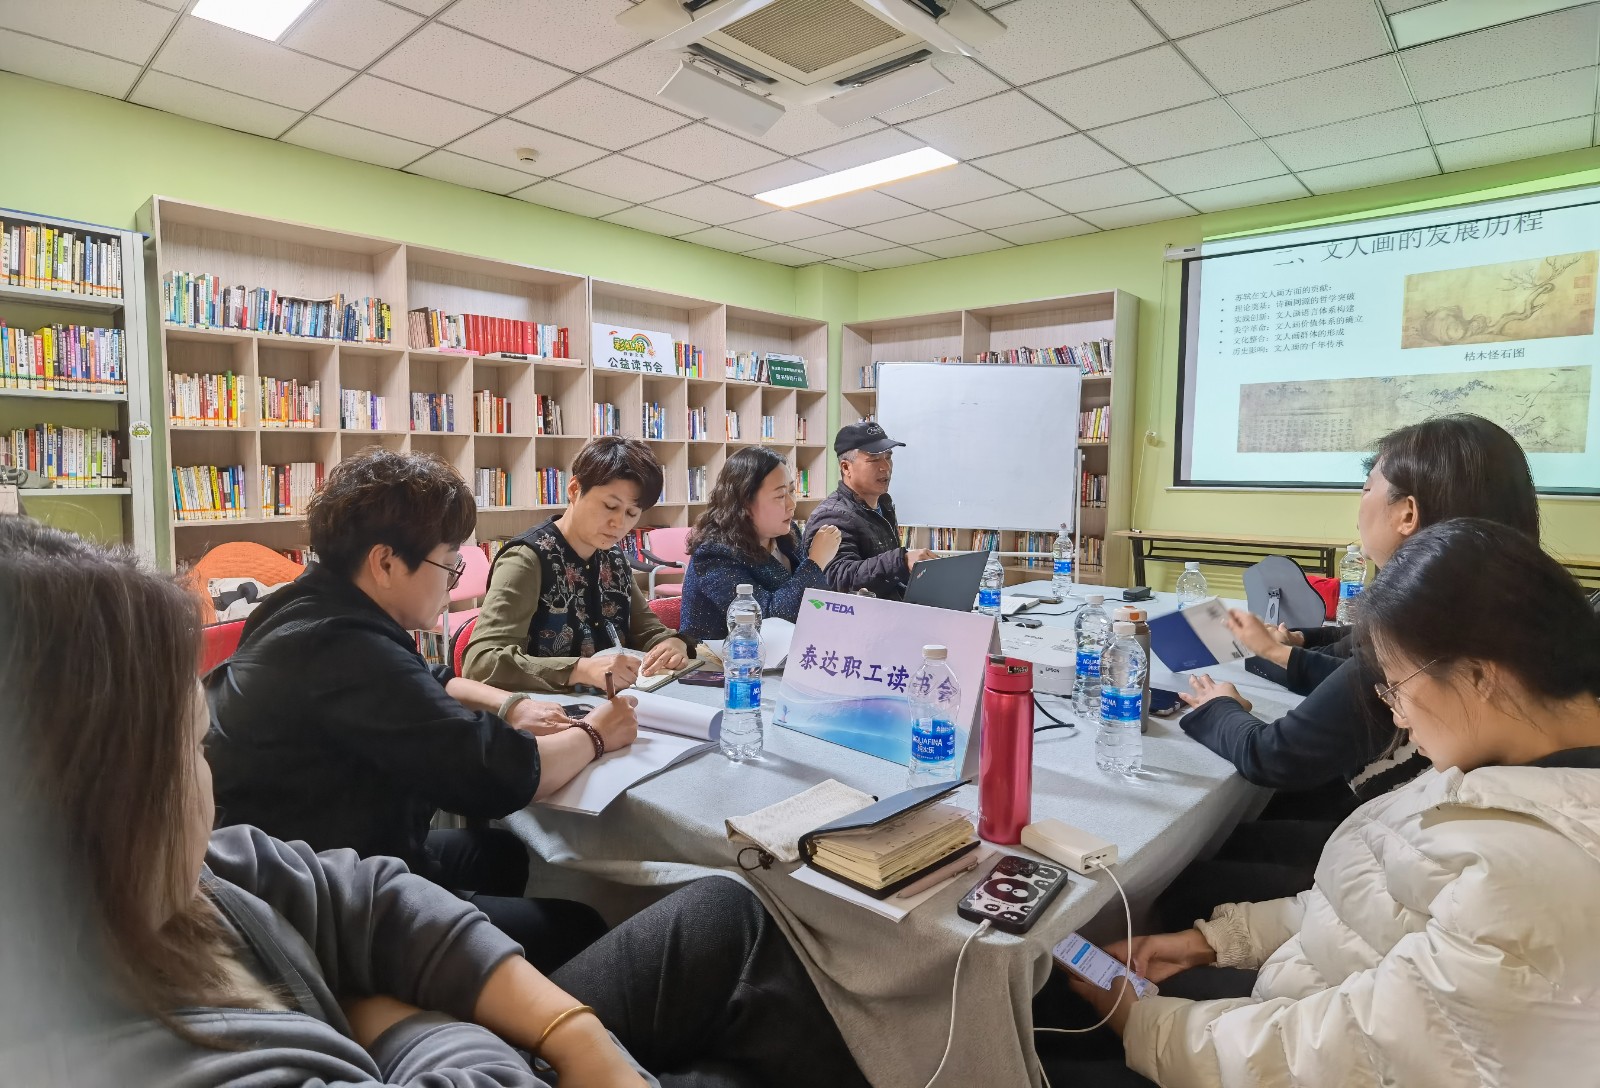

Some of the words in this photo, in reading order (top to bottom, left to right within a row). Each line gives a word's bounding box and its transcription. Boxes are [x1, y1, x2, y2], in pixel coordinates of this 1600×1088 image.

[613, 337, 646, 353] 彩虹桥
[1463, 347, 1526, 362] 枯木怪石图
[607, 356, 664, 374] 公益读书会
[824, 601, 855, 616] TEDA
[798, 643, 958, 702] 泰达职工读书会
